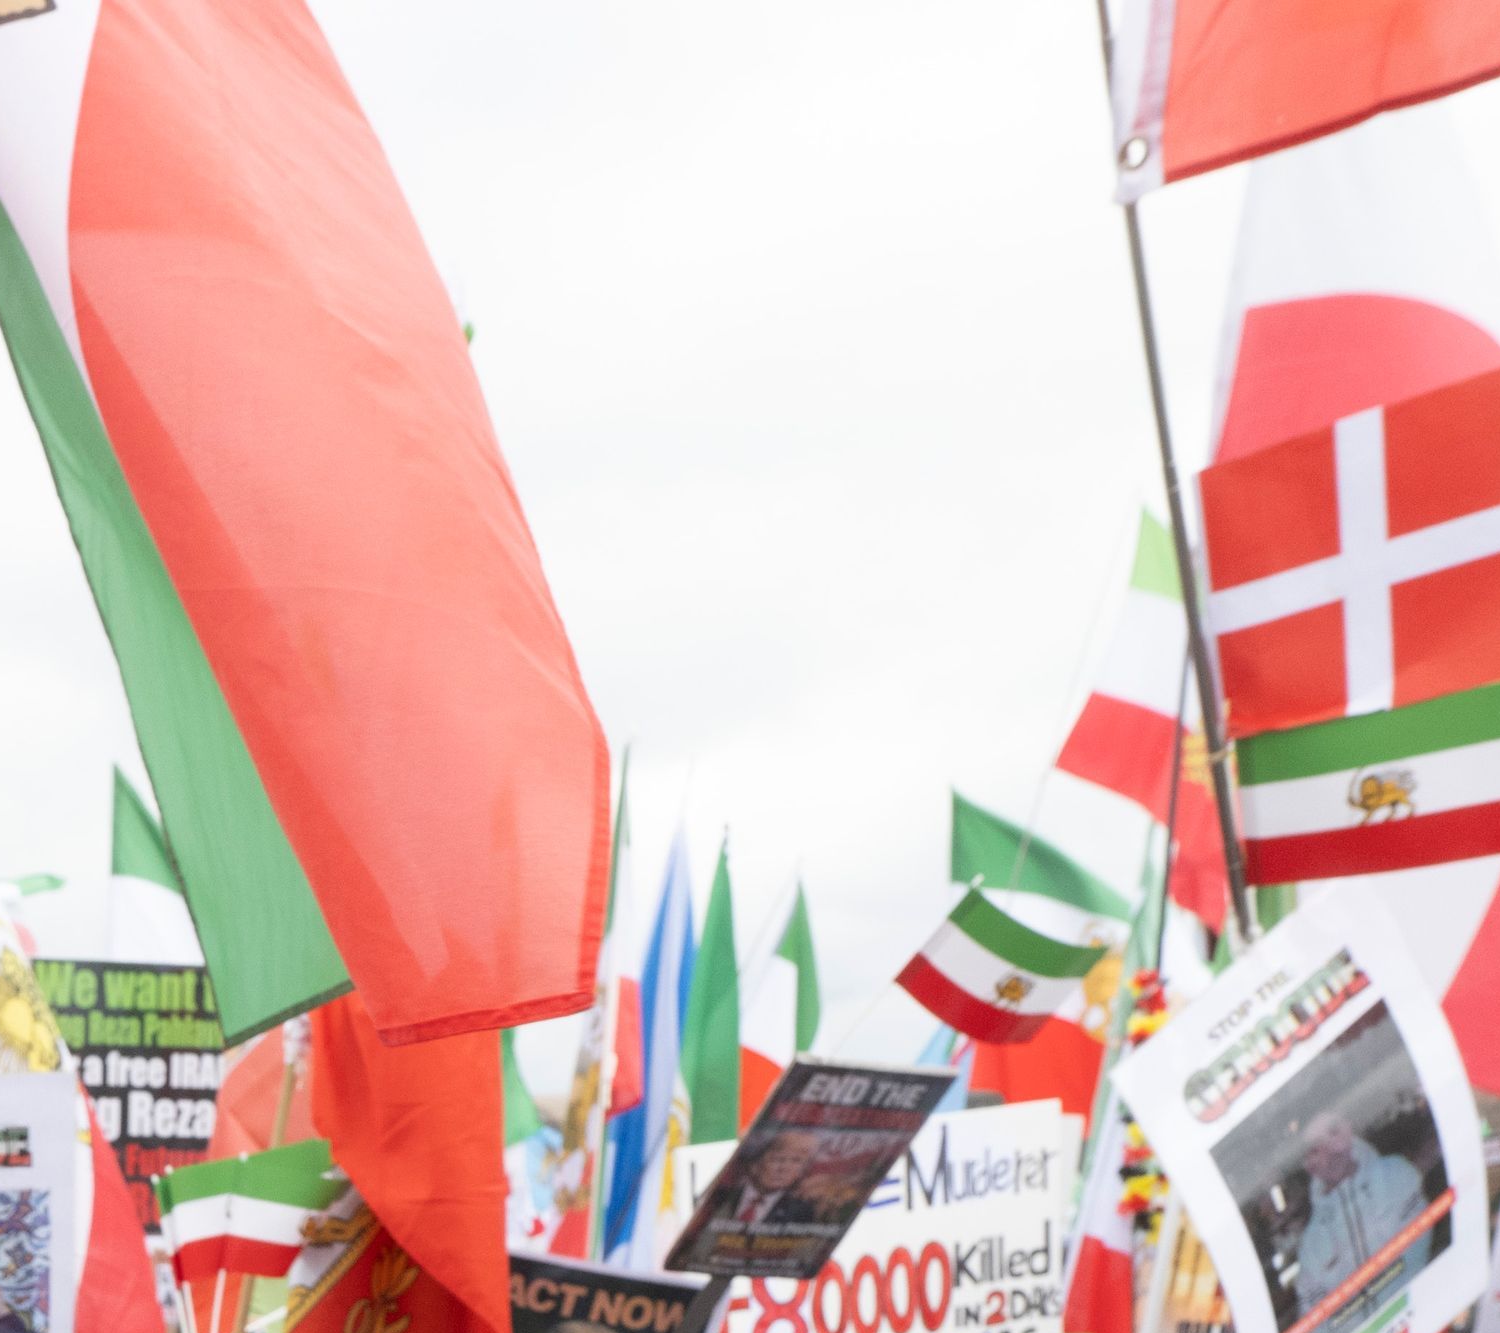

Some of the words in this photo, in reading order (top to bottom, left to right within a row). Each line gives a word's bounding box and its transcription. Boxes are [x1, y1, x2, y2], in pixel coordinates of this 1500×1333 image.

[33, 961, 98, 1008] We
[103, 968, 198, 1012] want
[106, 1051, 167, 1088] free
[127, 1091, 216, 1138] Reza
[953, 1220, 1050, 1287] Killed
[986, 1290, 1006, 1325] 2
